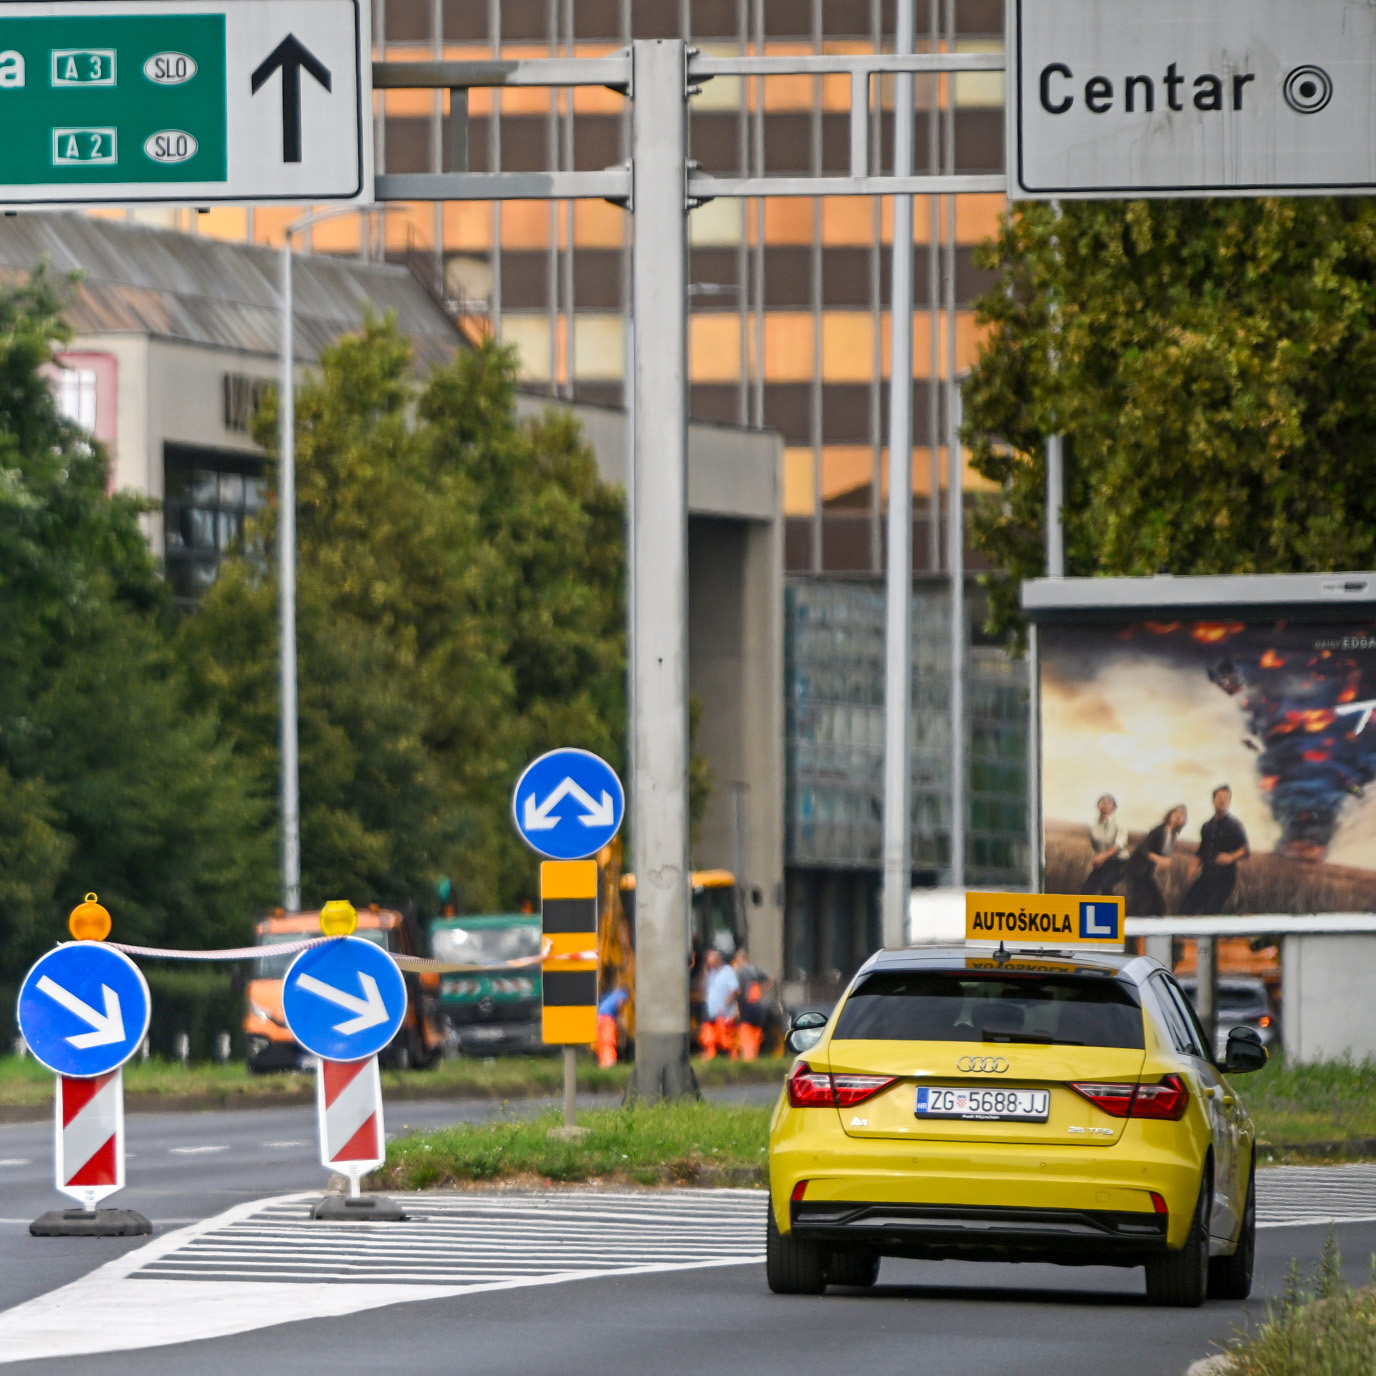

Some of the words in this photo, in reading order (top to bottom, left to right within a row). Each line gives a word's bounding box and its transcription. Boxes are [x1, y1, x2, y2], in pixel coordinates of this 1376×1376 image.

[154, 57, 187, 80] SLO
[1038, 61, 1256, 115] Centar
[154, 134, 188, 158] SLO
[972, 907, 1073, 934] AUTOŠKOLA
[1085, 904, 1113, 935] L
[930, 1090, 955, 1111] ZG
